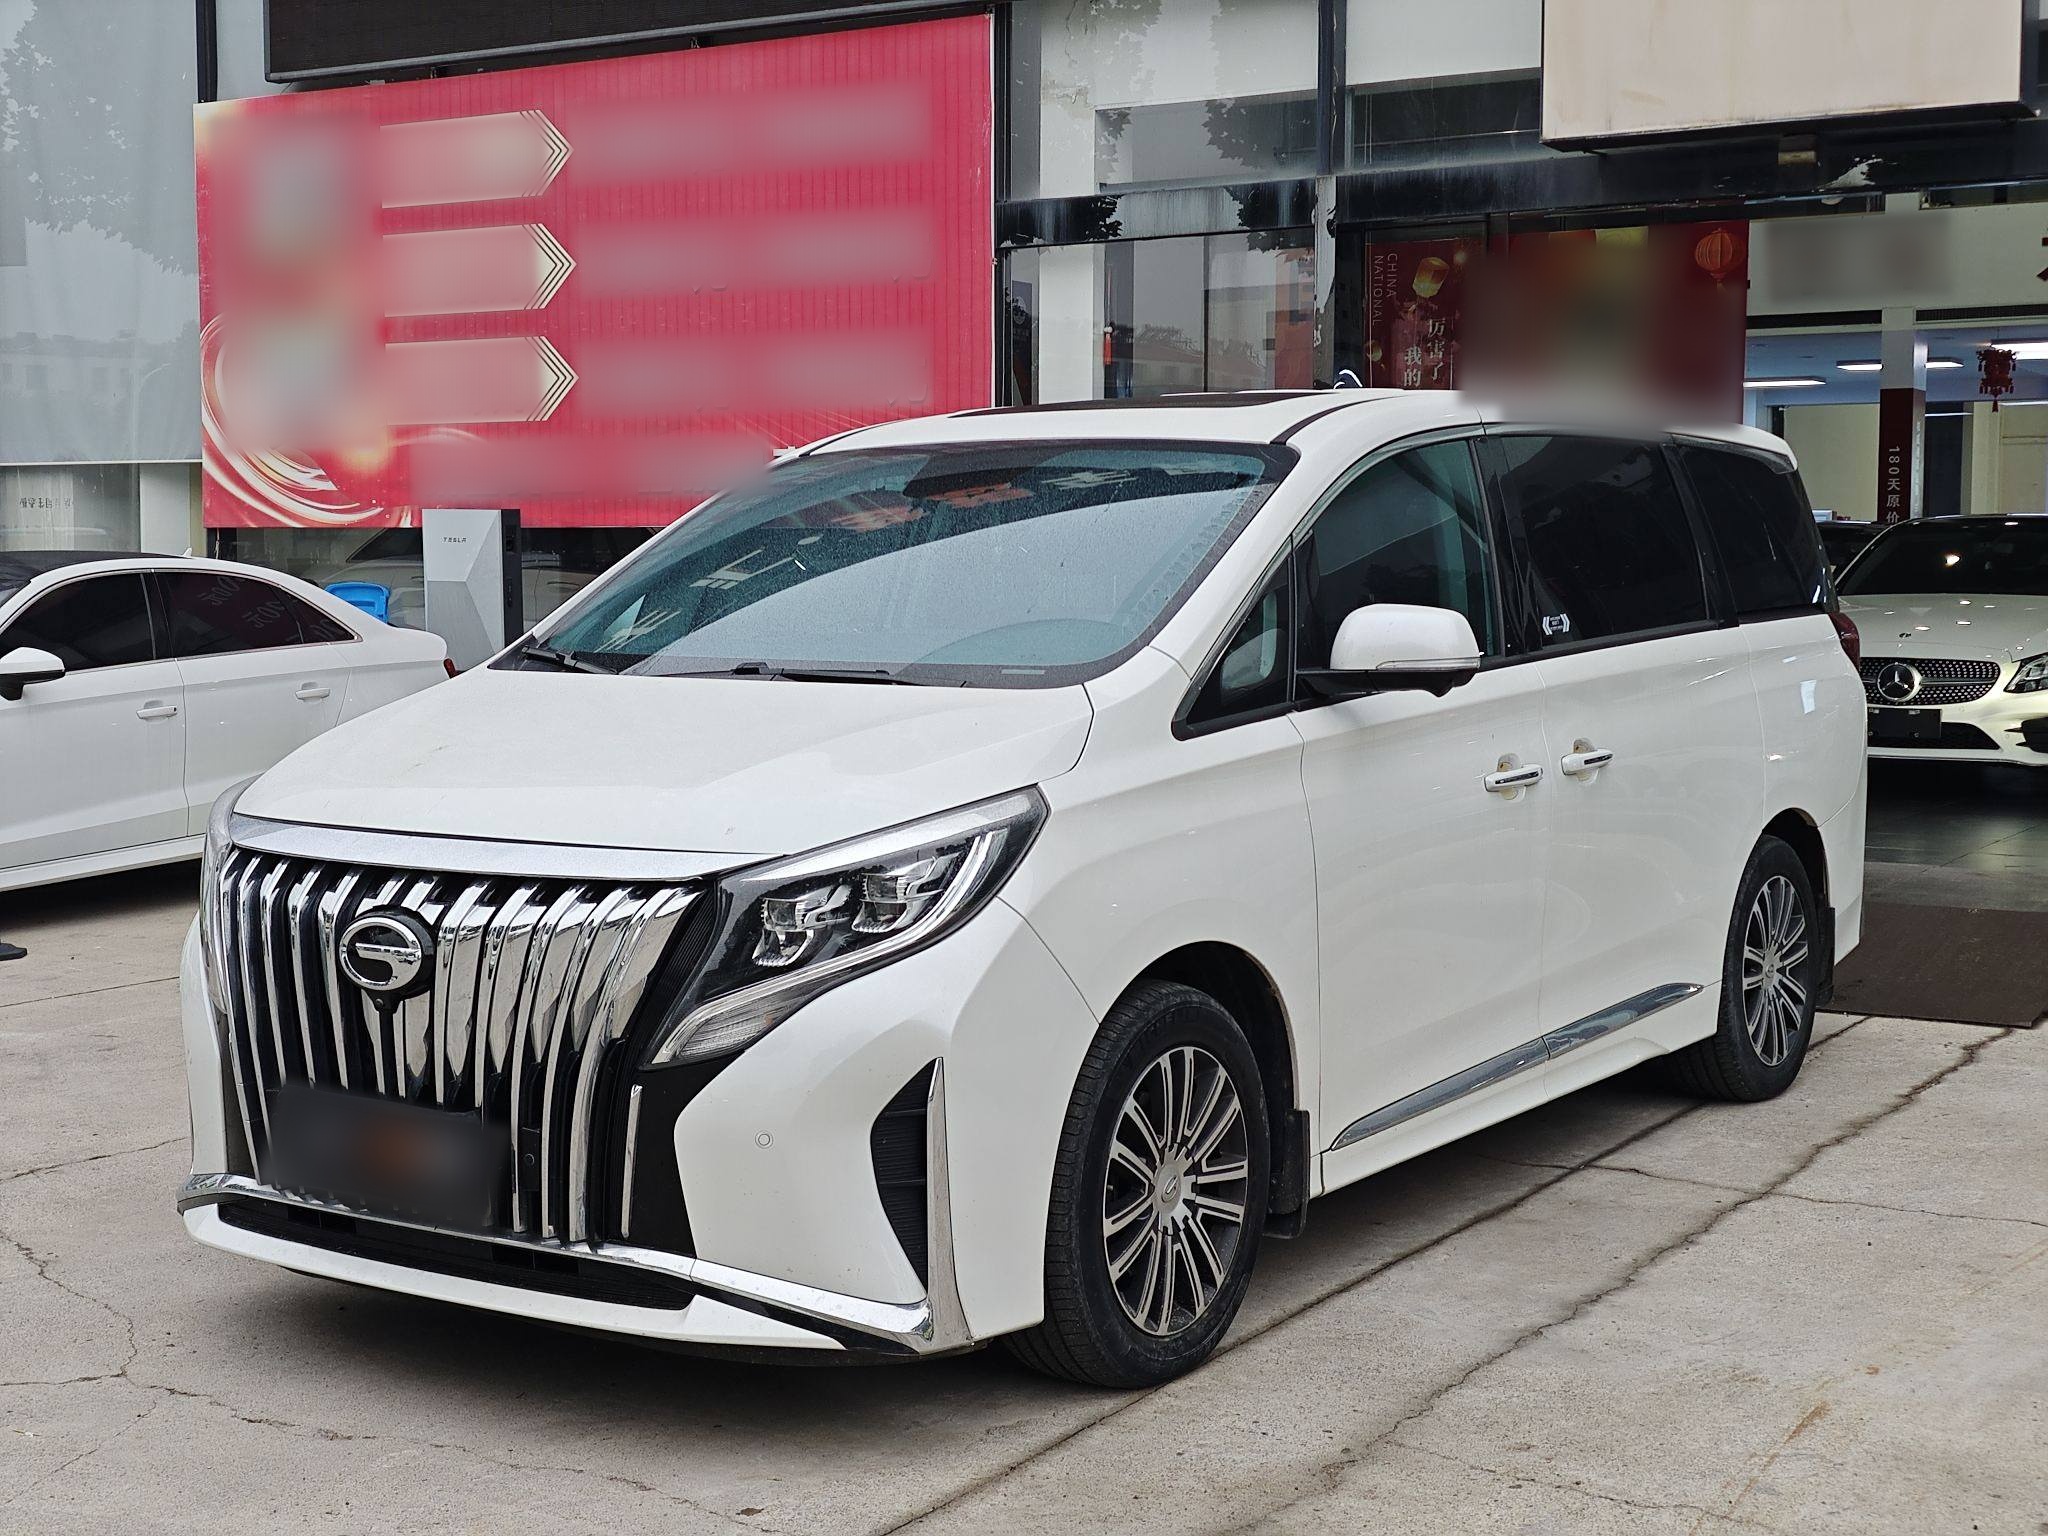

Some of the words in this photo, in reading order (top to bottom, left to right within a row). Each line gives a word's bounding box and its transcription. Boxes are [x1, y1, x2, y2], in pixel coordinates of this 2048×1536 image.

[1372, 255, 1384, 326] NATIONAL
[1386, 253, 1398, 297] CHINA
[1404, 345, 1422, 388] 我的
[1427, 317, 1446, 381] 厉害了
